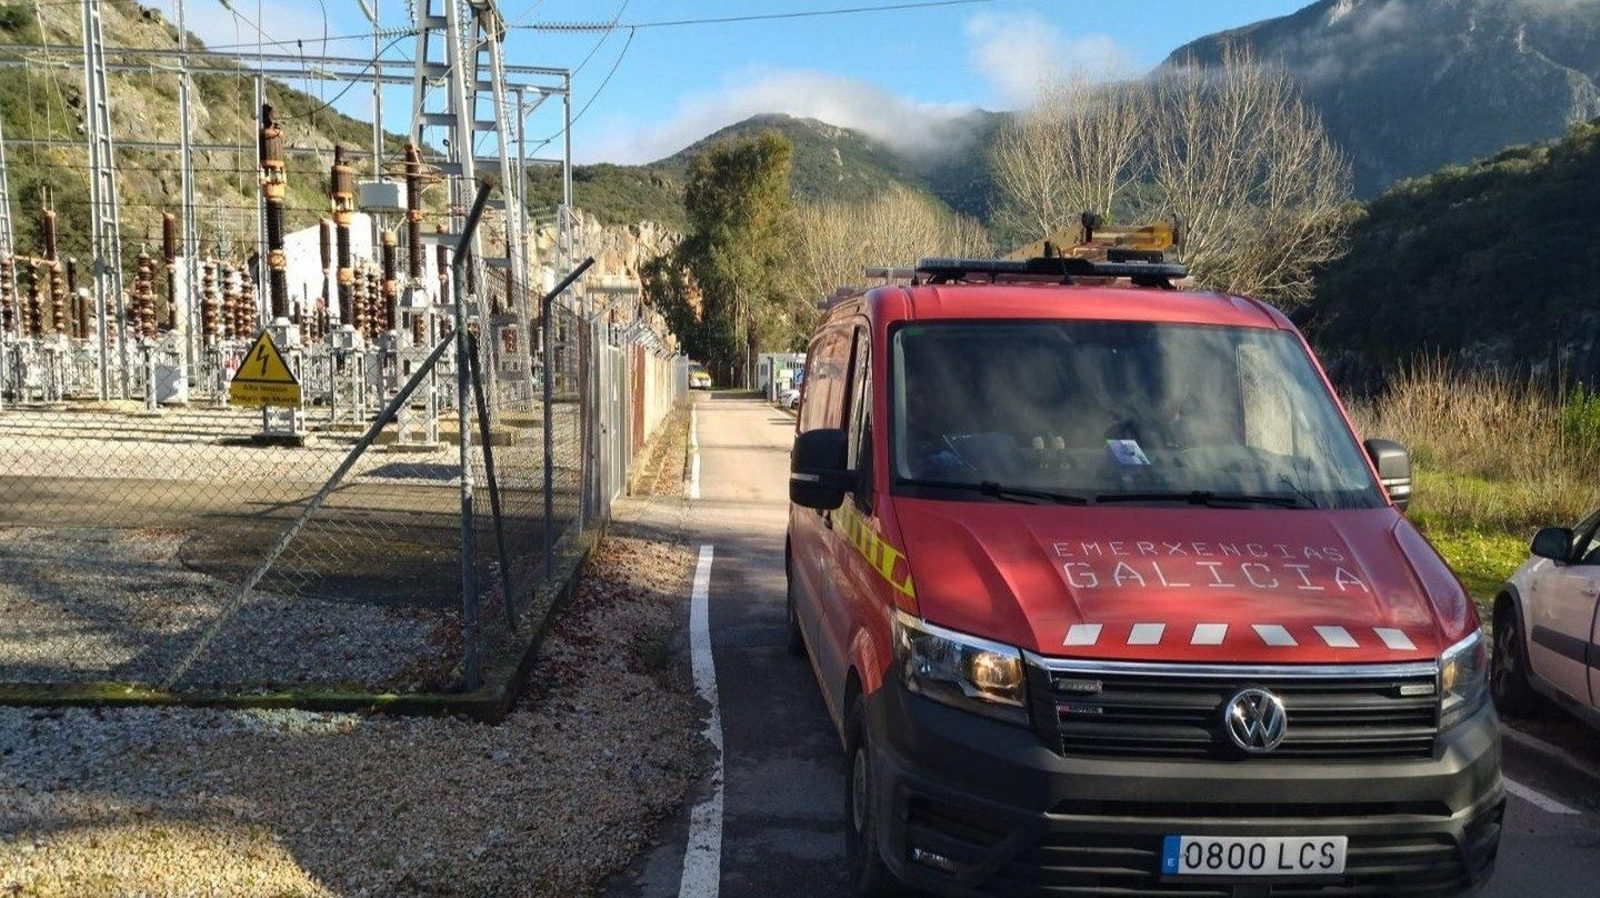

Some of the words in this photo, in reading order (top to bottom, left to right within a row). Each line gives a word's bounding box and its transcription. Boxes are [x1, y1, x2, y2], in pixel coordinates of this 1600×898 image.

[1053, 541, 1345, 562] EMERXENCIAS
[1063, 561, 1370, 593] GALICIA
[1184, 841, 1266, 870] 0800
[1277, 841, 1336, 870] LCS
